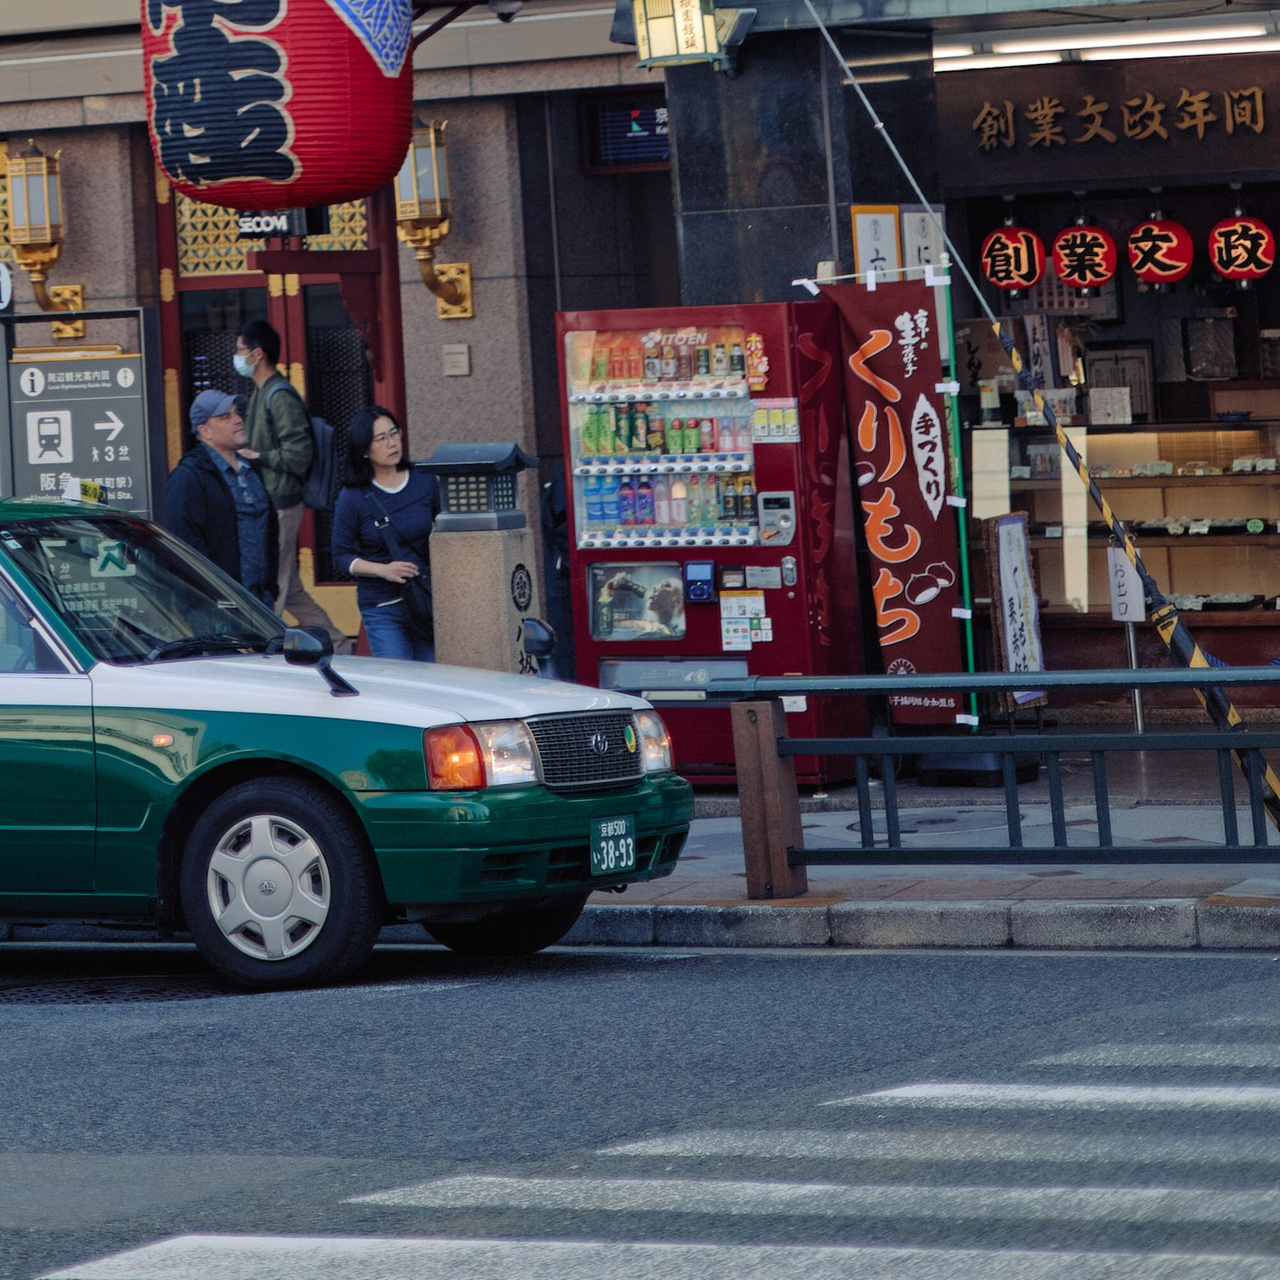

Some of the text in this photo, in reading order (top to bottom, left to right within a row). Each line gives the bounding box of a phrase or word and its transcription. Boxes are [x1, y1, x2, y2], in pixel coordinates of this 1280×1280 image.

[972, 85, 1266, 150] 創業文政年間
[239, 215, 288, 232] SECOM
[894, 311, 920, 378] 生菓子
[104, 445, 114, 461] 3
[915, 412, 941, 501] 手づくり
[849, 329, 921, 646] くりもち
[889, 695, 956, 708] 子協同組合加盟店
[600, 837, 634, 870] 38-93
